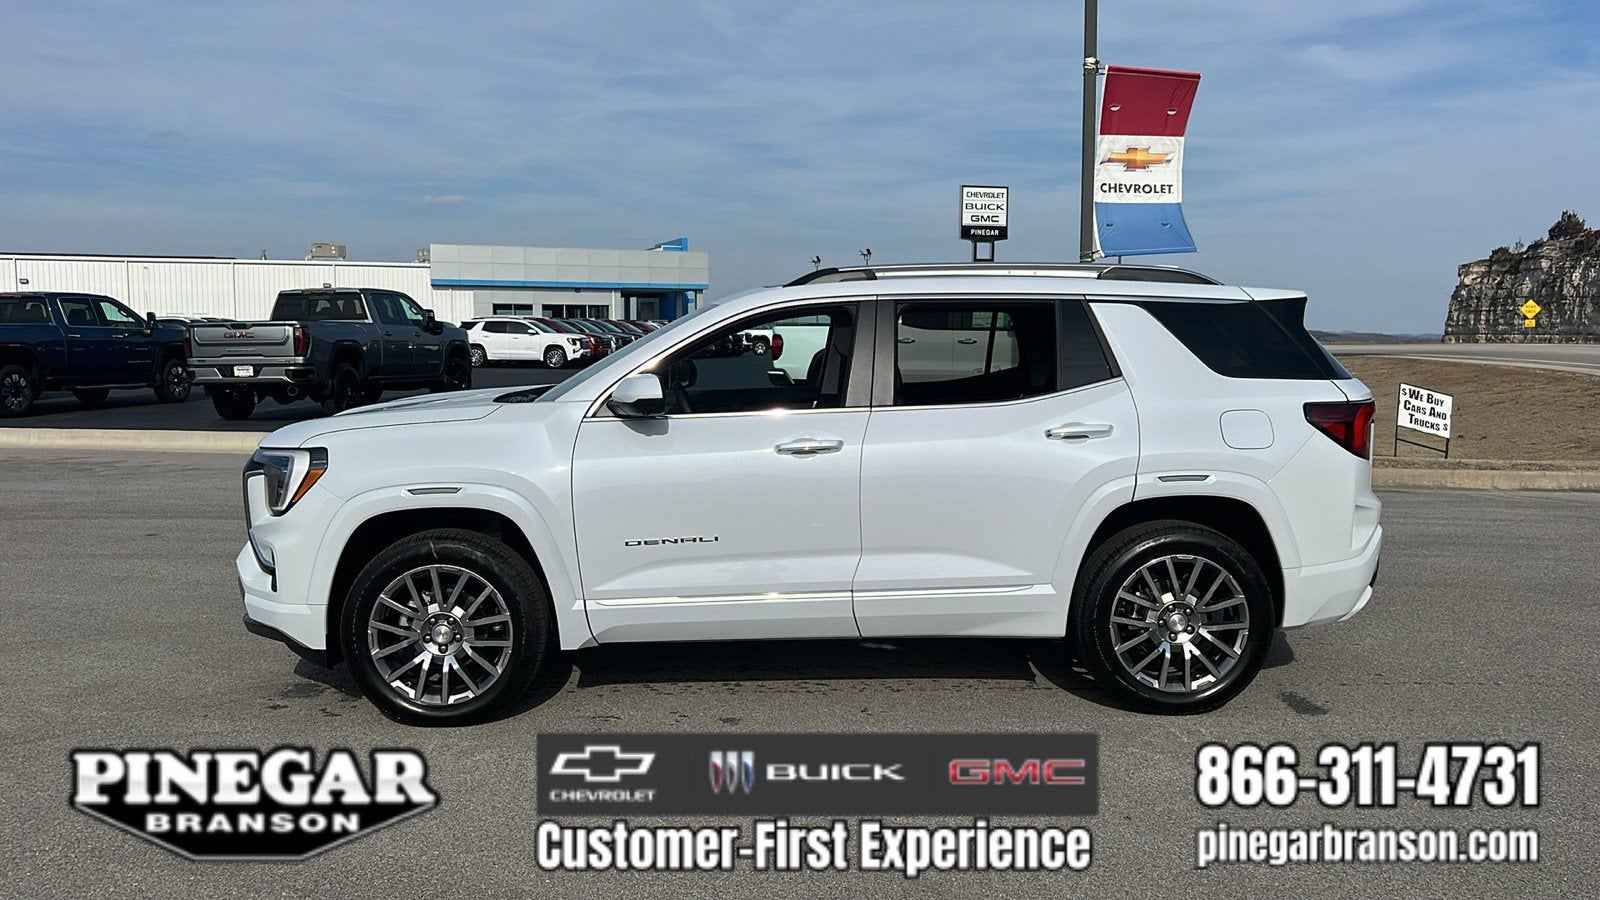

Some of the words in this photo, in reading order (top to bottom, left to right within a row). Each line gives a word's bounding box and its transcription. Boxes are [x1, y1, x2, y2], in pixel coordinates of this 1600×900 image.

[1100, 182, 1174, 194] CHEVROLET
[966, 191, 1005, 199] CHEVROLET
[965, 203, 1005, 211] BUICK
[970, 215, 1000, 223] GMC
[625, 536, 719, 546] DENALI
